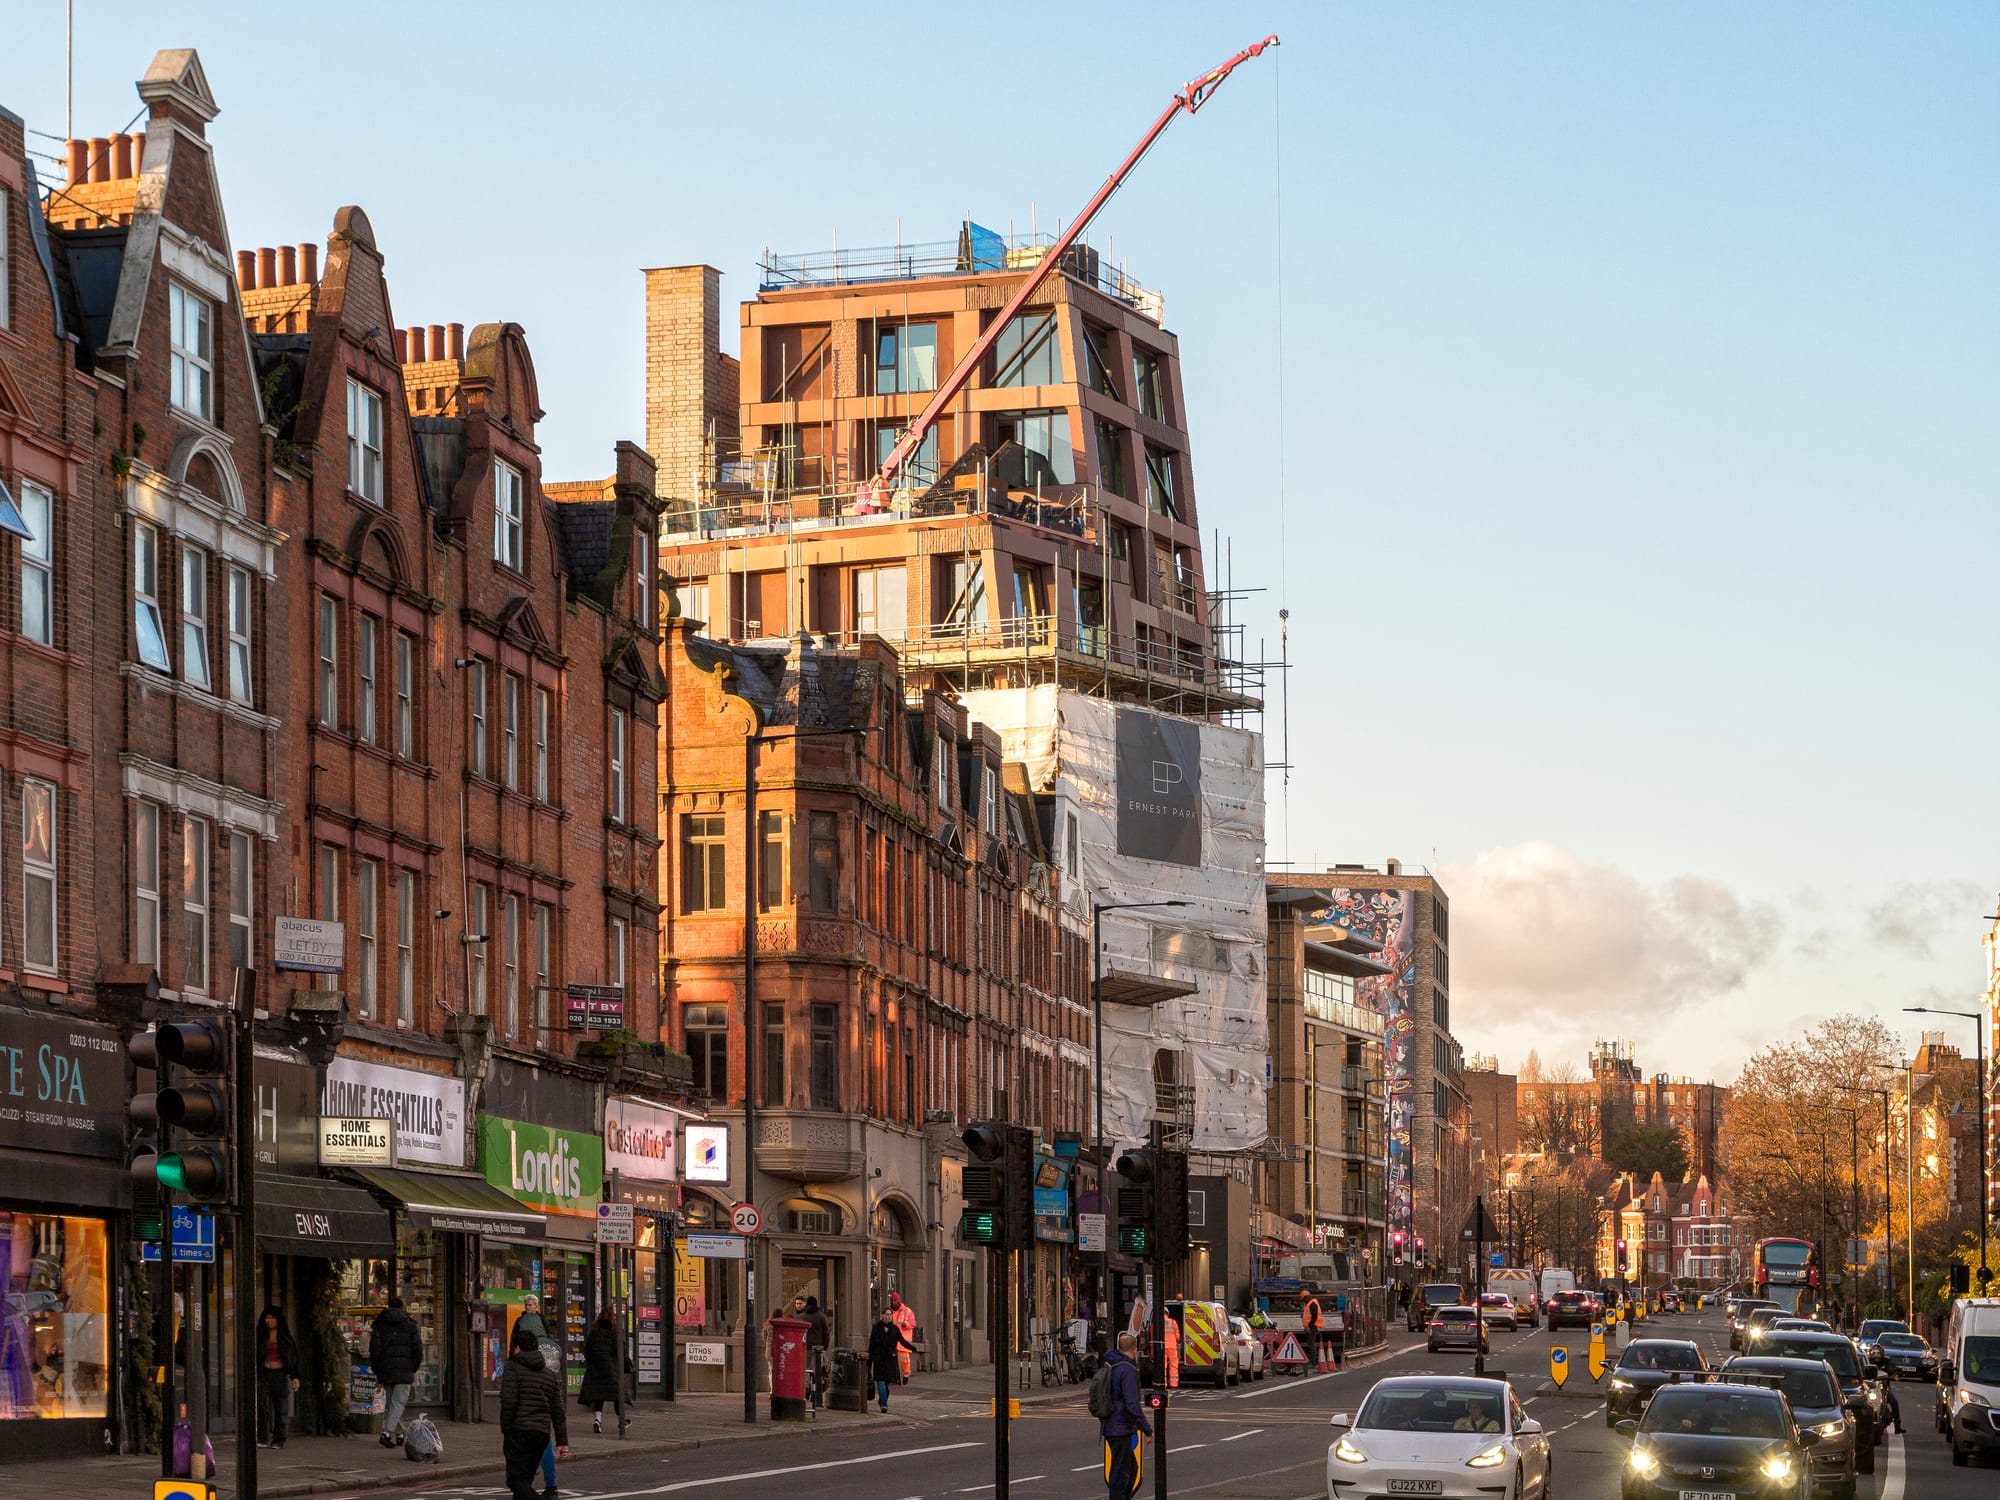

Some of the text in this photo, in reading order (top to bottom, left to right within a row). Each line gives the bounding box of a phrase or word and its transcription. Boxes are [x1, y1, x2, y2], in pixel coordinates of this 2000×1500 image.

[1129, 800, 1197, 820] ERNEST PARK
[281, 920, 322, 933] abacus
[289, 939, 328, 954] LET BY
[280, 952, 337, 965] 020 7431 3777
[573, 1001, 618, 1012] LET BY
[603, 1017, 622, 1025] 1933
[69, 1033, 118, 1053] 0203 112 0021
[329, 1079, 443, 1137] HOME ESSENTIALS
[25, 1111, 46, 1124] STEAM
[46, 1114, 64, 1126] ROOM
[66, 1117, 96, 1131] MASSAGE
[341, 1120, 371, 1133] HOME
[325, 1134, 386, 1148] ESSENTIALS
[260, 1150, 277, 1164] GRILL
[510, 1129, 581, 1199] Londis
[295, 1213, 331, 1237] ENISH
[736, 1213, 757, 1226] 20
[180, 1247, 202, 1257] times
[676, 1268, 697, 1283] ILE
[688, 1347, 712, 1355] LITHOS
[688, 1354, 708, 1362] ROAD
[1391, 1481, 1438, 1491] GJ22 KXF
